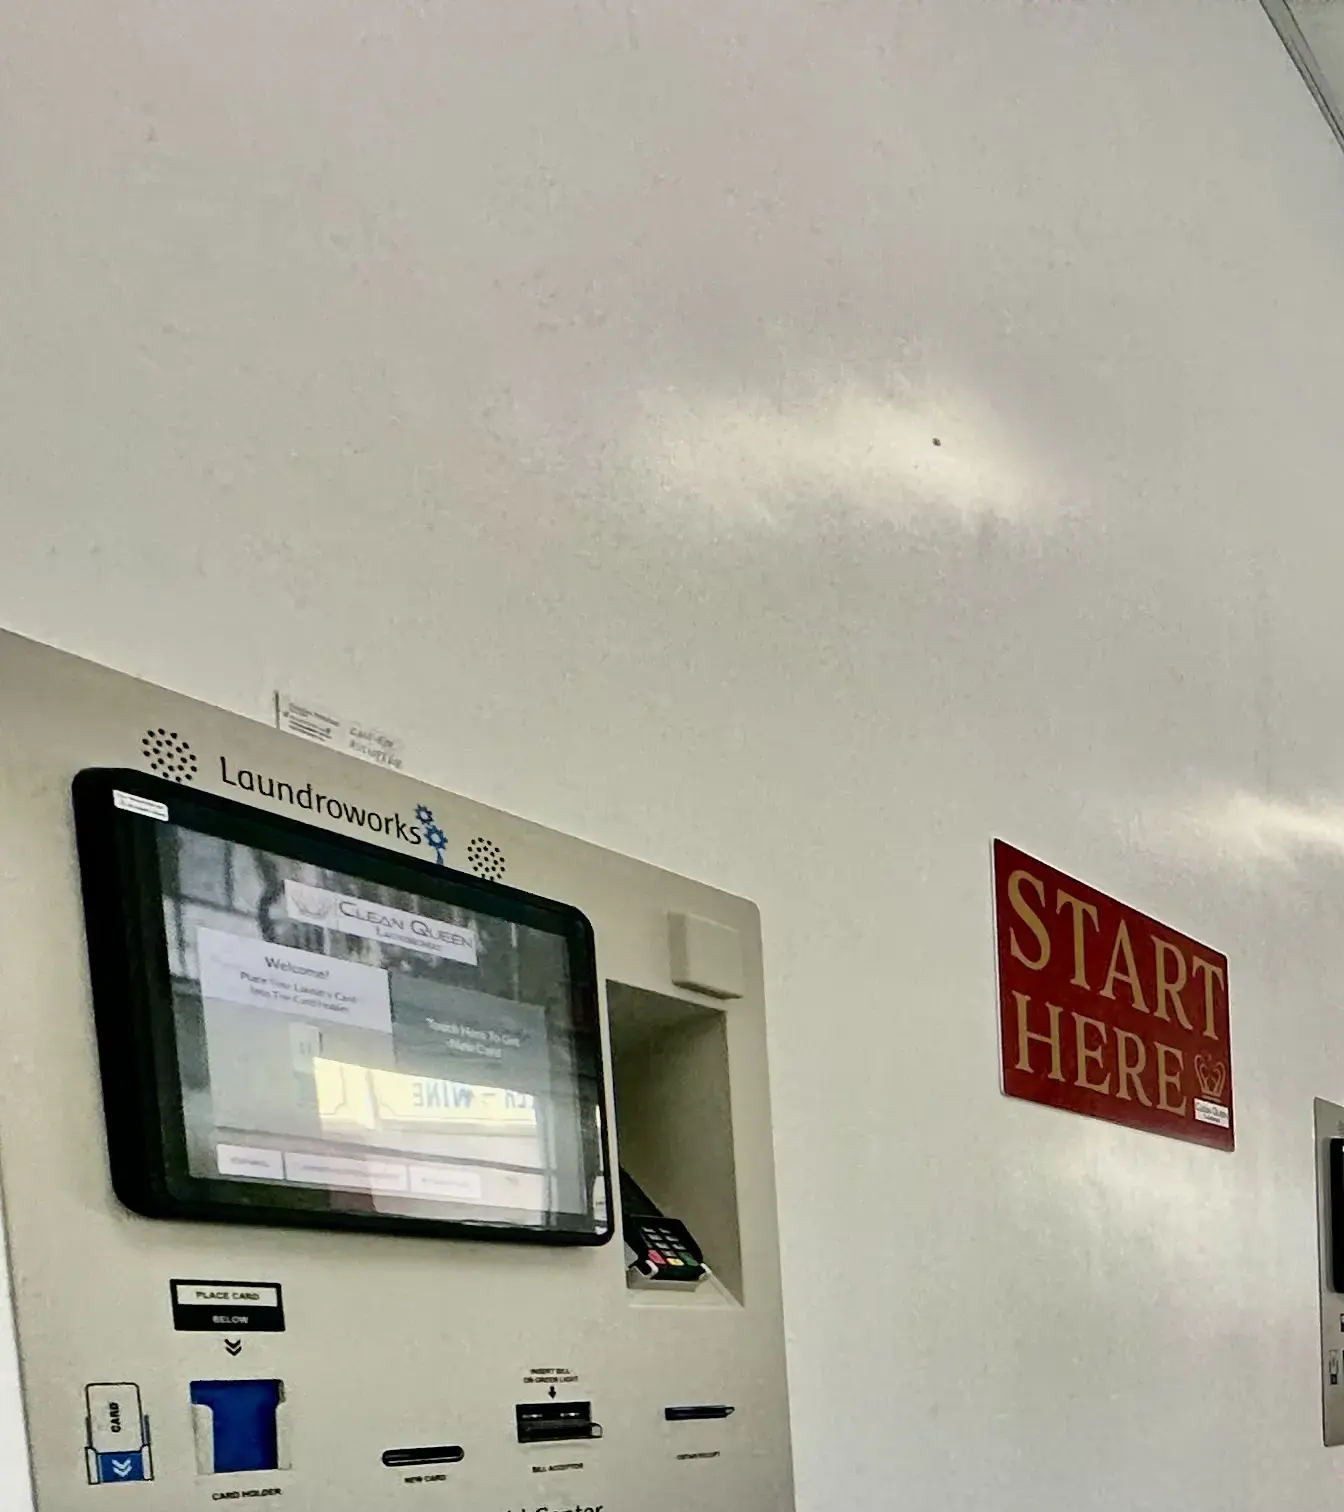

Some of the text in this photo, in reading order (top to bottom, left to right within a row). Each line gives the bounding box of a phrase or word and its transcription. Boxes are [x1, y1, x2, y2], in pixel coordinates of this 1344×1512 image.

[220, 756, 422, 845] Laundroworks
[265, 956, 329, 980] Welcome!
[1007, 869, 1225, 1041] START
[1012, 989, 1187, 1117] HERE
[212, 1314, 249, 1325] BELOW
[110, 1401, 121, 1433] CARD
